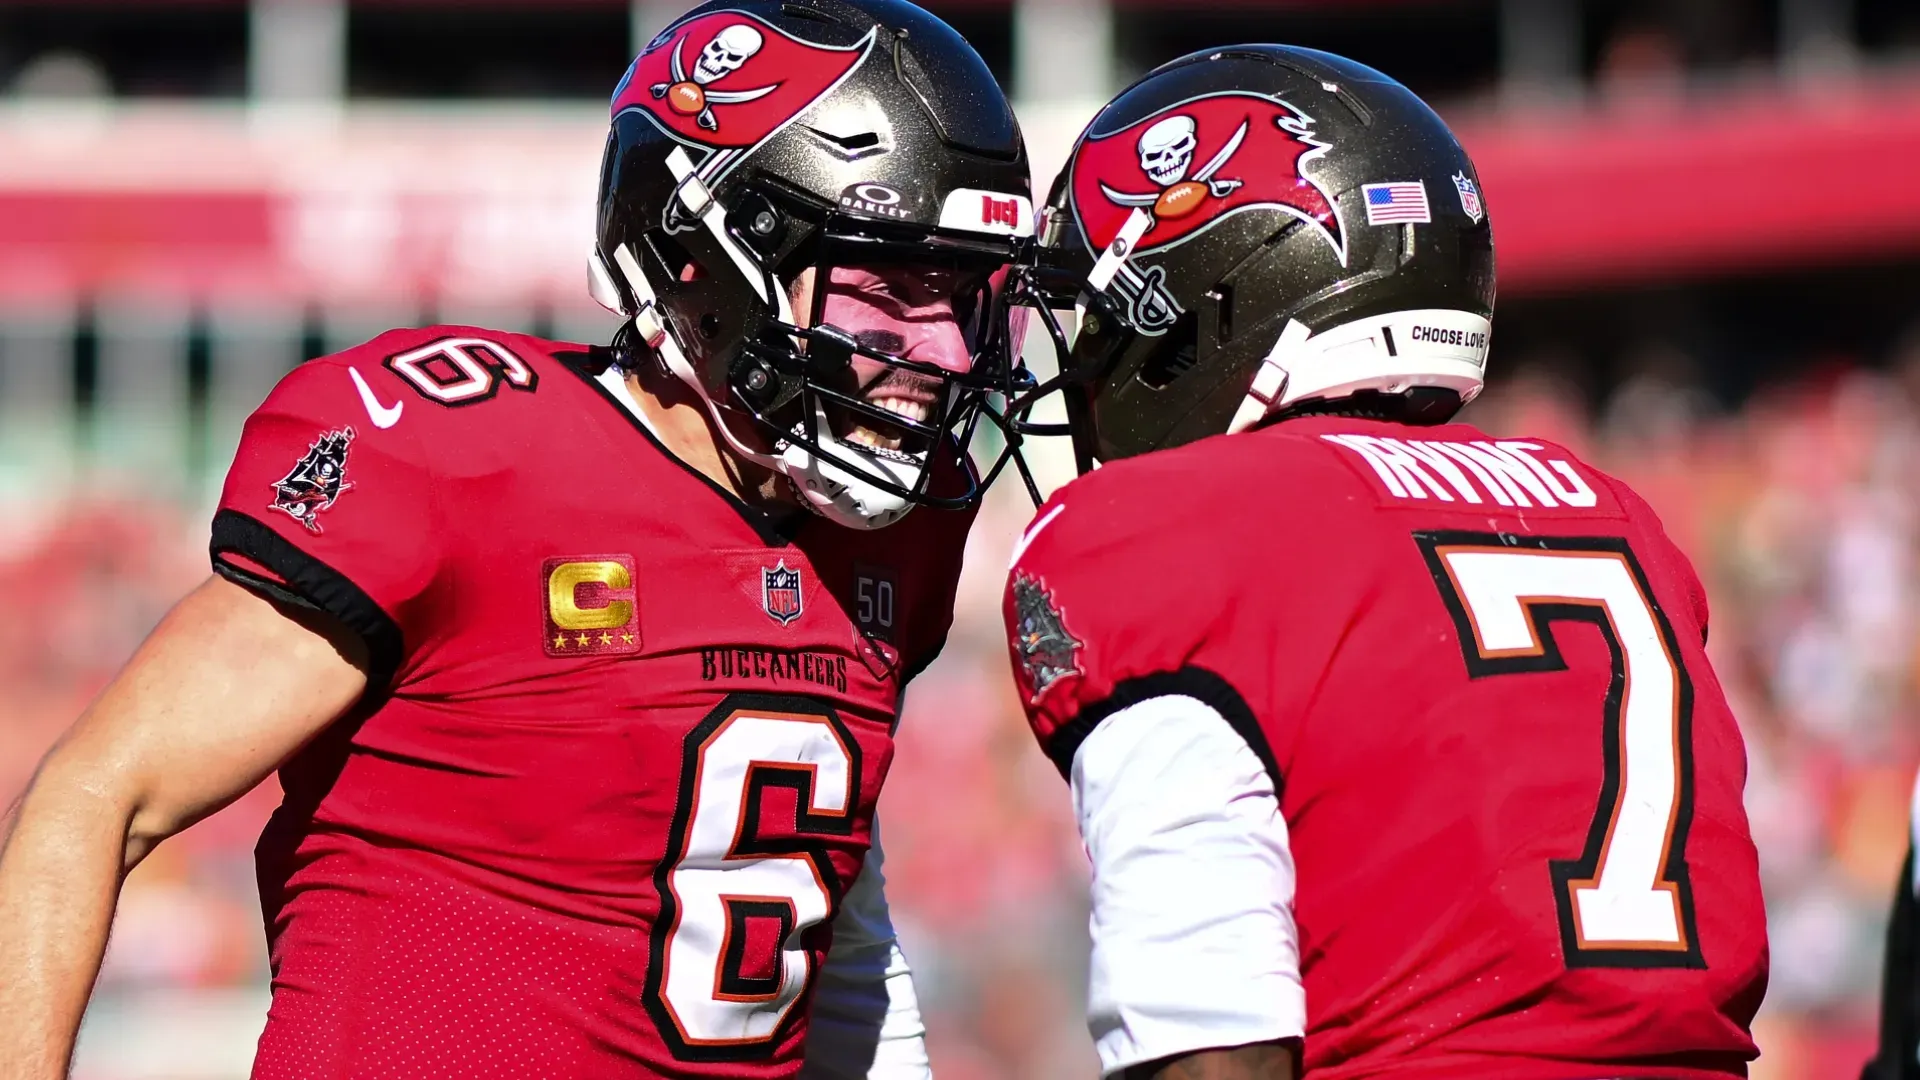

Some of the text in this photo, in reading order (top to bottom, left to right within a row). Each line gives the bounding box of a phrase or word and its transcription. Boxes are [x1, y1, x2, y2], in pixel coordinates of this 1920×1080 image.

[841, 196, 912, 219] OAKLEY
[1462, 193, 1481, 214] NFL
[1412, 325, 1485, 349] CHOOSE LOVE
[381, 335, 539, 408] 6
[1320, 434, 1597, 507] IRVING
[549, 561, 632, 629] C
[769, 590, 798, 614] NFL
[858, 577, 892, 627] 50
[702, 649, 847, 694] BUCCANEERS
[1412, 529, 1708, 969] 7
[642, 692, 862, 1061] 6
